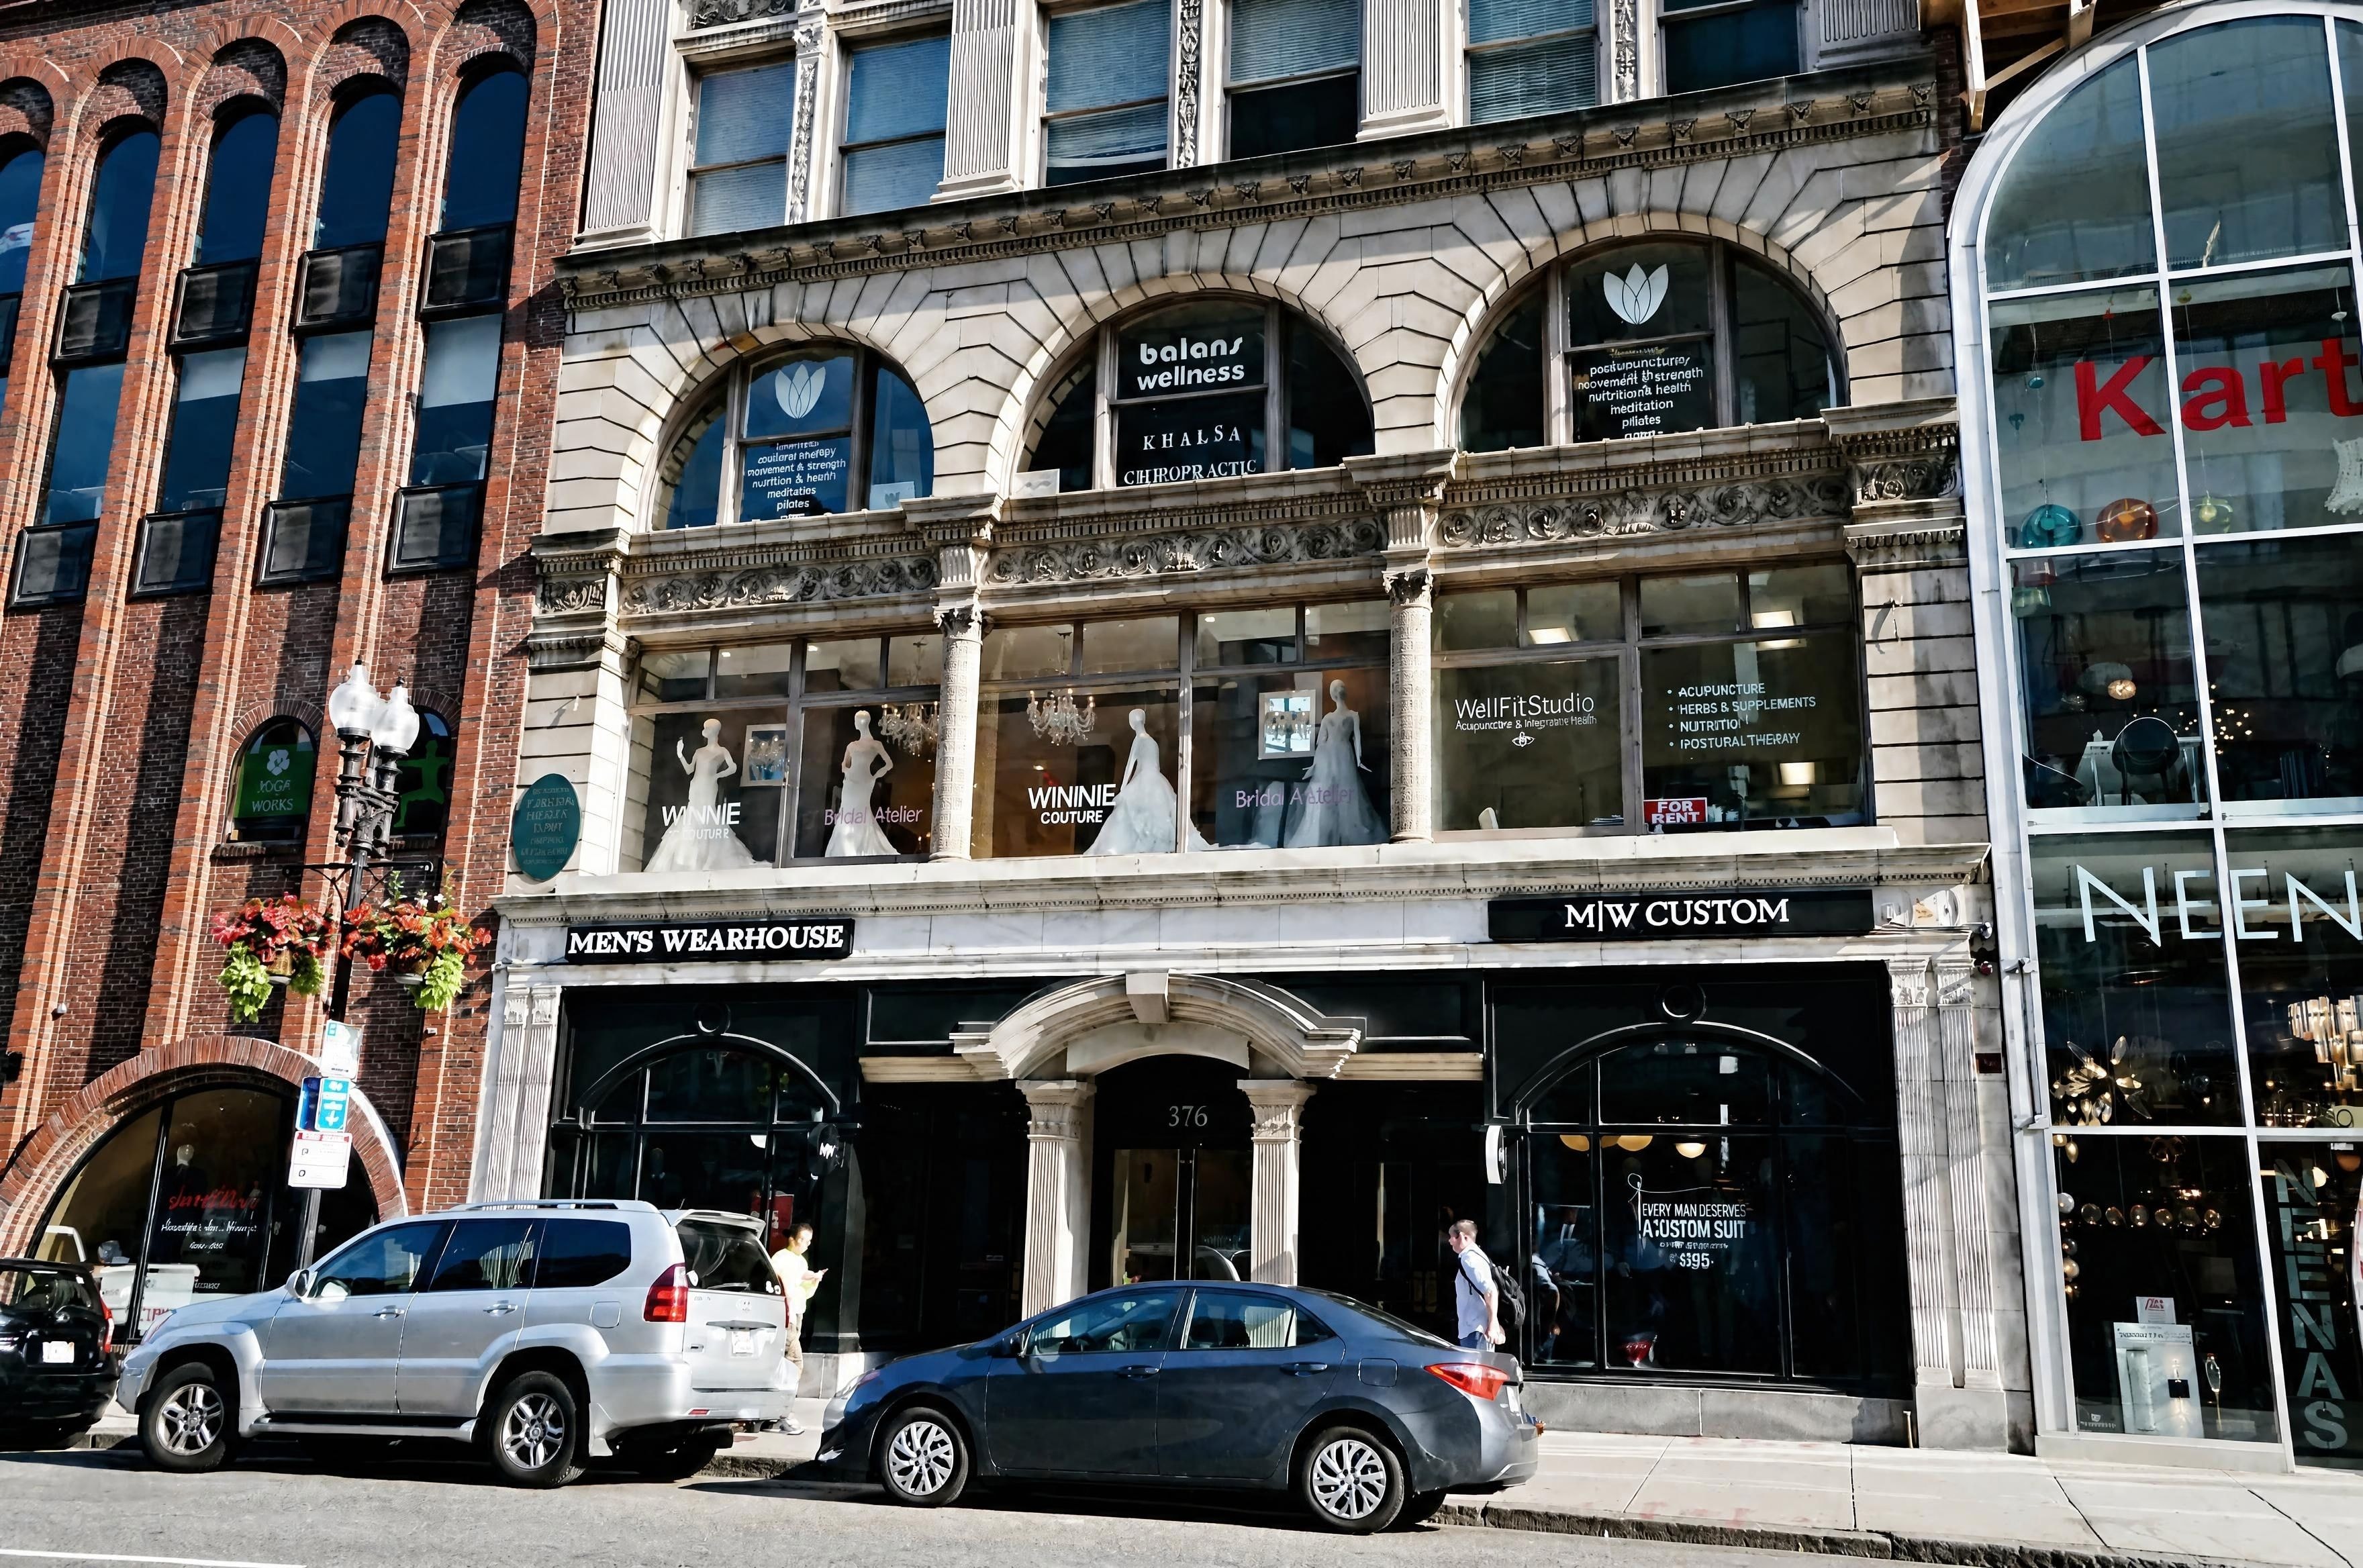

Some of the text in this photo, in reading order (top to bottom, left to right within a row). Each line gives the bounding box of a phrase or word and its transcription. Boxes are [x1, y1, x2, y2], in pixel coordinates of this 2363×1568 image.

[1141, 336, 1243, 364] balans
[1137, 364, 1245, 390] wellness
[2074, 338, 2363, 441] Kart
[1143, 425, 1241, 450] KHALSA
[807, 458, 846, 470] strength
[776, 499, 810, 511] pilates
[1678, 683, 1766, 697] ACUPUNCTURE
[1680, 703, 1718, 715] HERBS
[1732, 697, 1816, 711] SUPPLEMENTS
[1516, 720, 1523, 729] &
[252, 799, 293, 812] WORKS
[662, 802, 741, 826] WINNIE
[875, 805, 923, 824] Atelier
[1657, 800, 1693, 814] FOR
[1041, 810, 1103, 824] COUTURE
[1651, 812, 1700, 824] RENT
[1645, 898, 1789, 926] CUSTOM
[568, 925, 844, 954] MEN'S WEARHOUSE
[1169, 1106, 1208, 1127] 376
[1642, 1203, 1746, 1218] EVERY MAN DESERVES
[1642, 1219, 1653, 1238] A
[1714, 1220, 1746, 1238] SUIT
